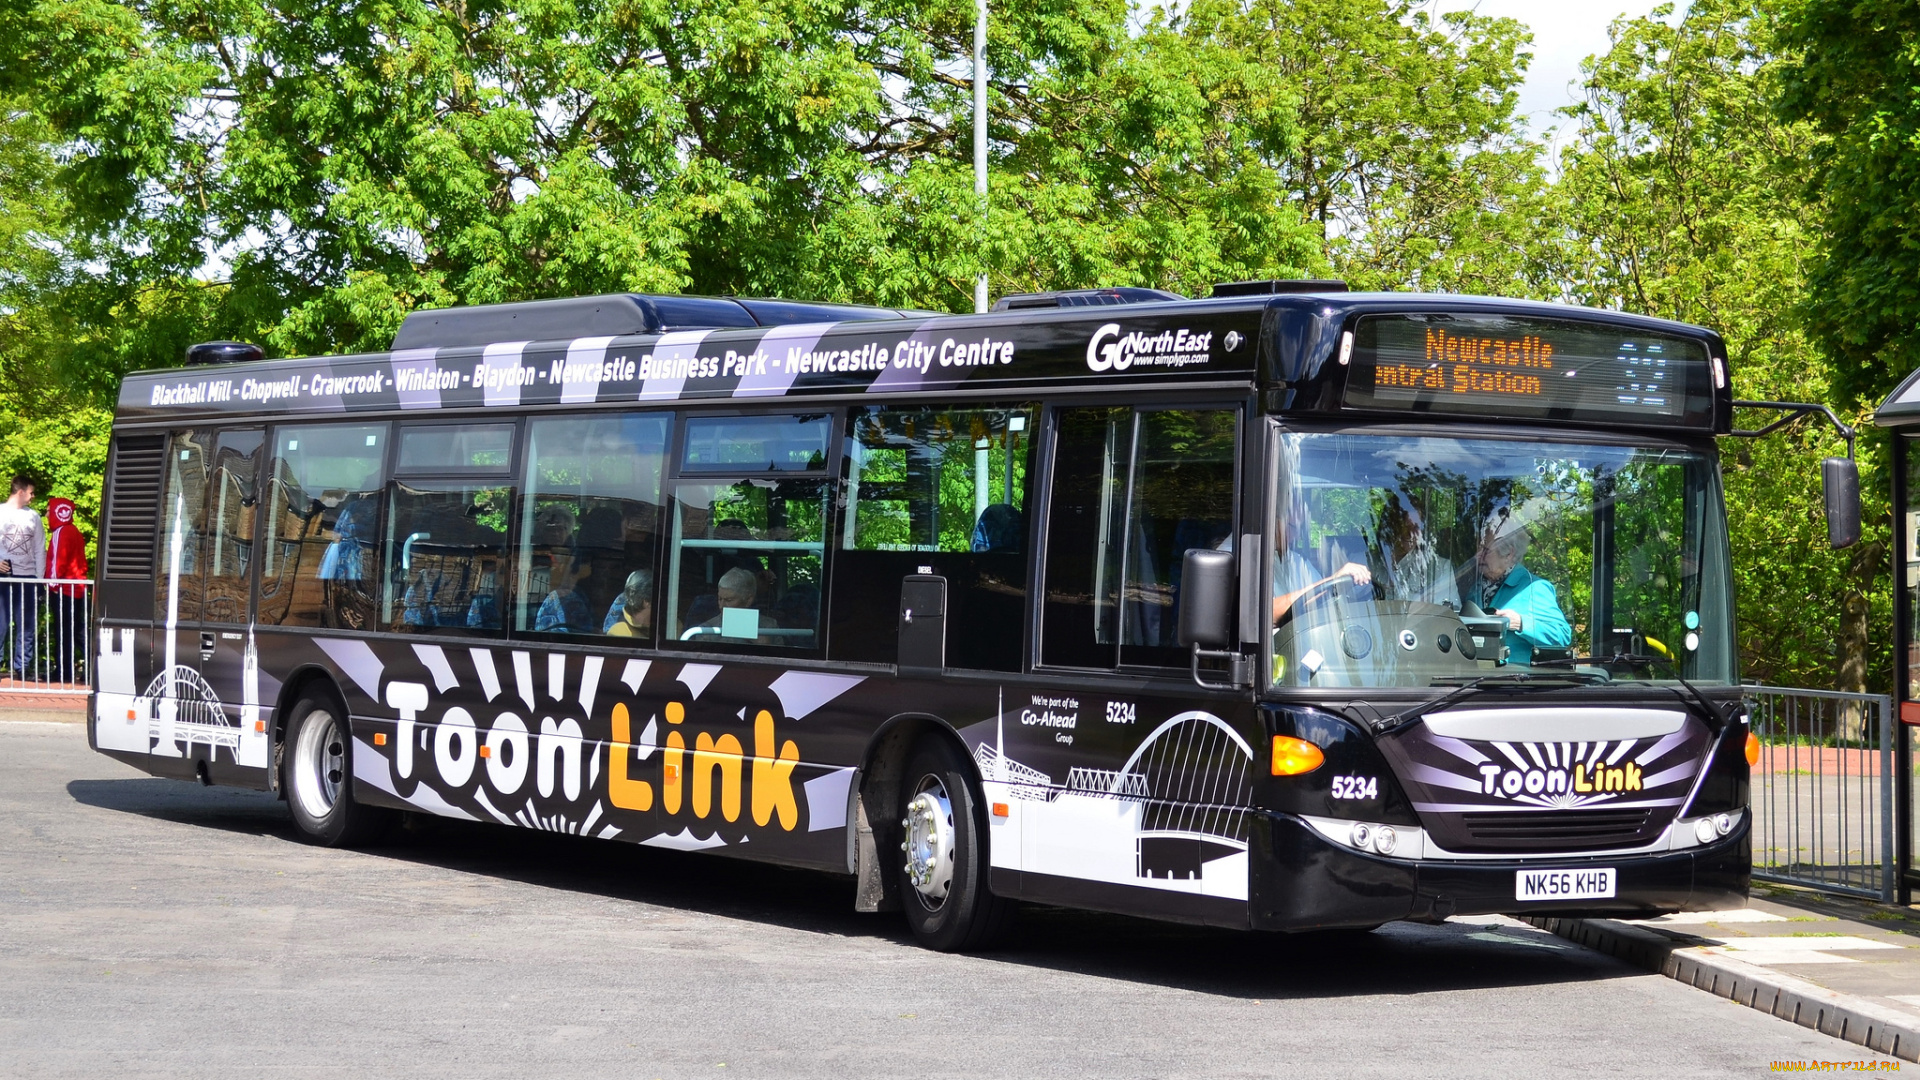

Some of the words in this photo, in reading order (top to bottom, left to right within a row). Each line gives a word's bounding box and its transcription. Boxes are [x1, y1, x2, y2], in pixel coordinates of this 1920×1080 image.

[1425, 328, 1553, 369] Newcastle
[151, 382, 207, 406] Blackhall
[207, 380, 232, 402] Mill
[241, 376, 301, 404] Chopwell
[310, 370, 384, 396] Crawcrook
[396, 367, 460, 391] Winlaton
[472, 363, 536, 392] Blaydon
[549, 356, 636, 384] Newcastle
[638, 353, 720, 380] Business
[722, 349, 769, 377] Park
[785, 342, 889, 374] Newcastle
[893, 340, 937, 374] City
[939, 337, 1015, 367] Centre
[1453, 364, 1541, 394] Station
[1031, 694, 1048, 706] We're
[1049, 697, 1061, 709] part
[1062, 697, 1070, 710] of
[1069, 698, 1079, 709] the
[1106, 701, 1136, 724] 5234
[1021, 709, 1077, 729] Go-Ahead
[1055, 732, 1074, 746] Group
[386, 681, 584, 802] Toon
[608, 702, 800, 832] Link
[1331, 776, 1378, 800] 5234
[1479, 765, 1567, 795] Toon
[1574, 762, 1642, 793] Link
[1525, 873, 1571, 895] NK56
[1575, 872, 1608, 893] KHB
